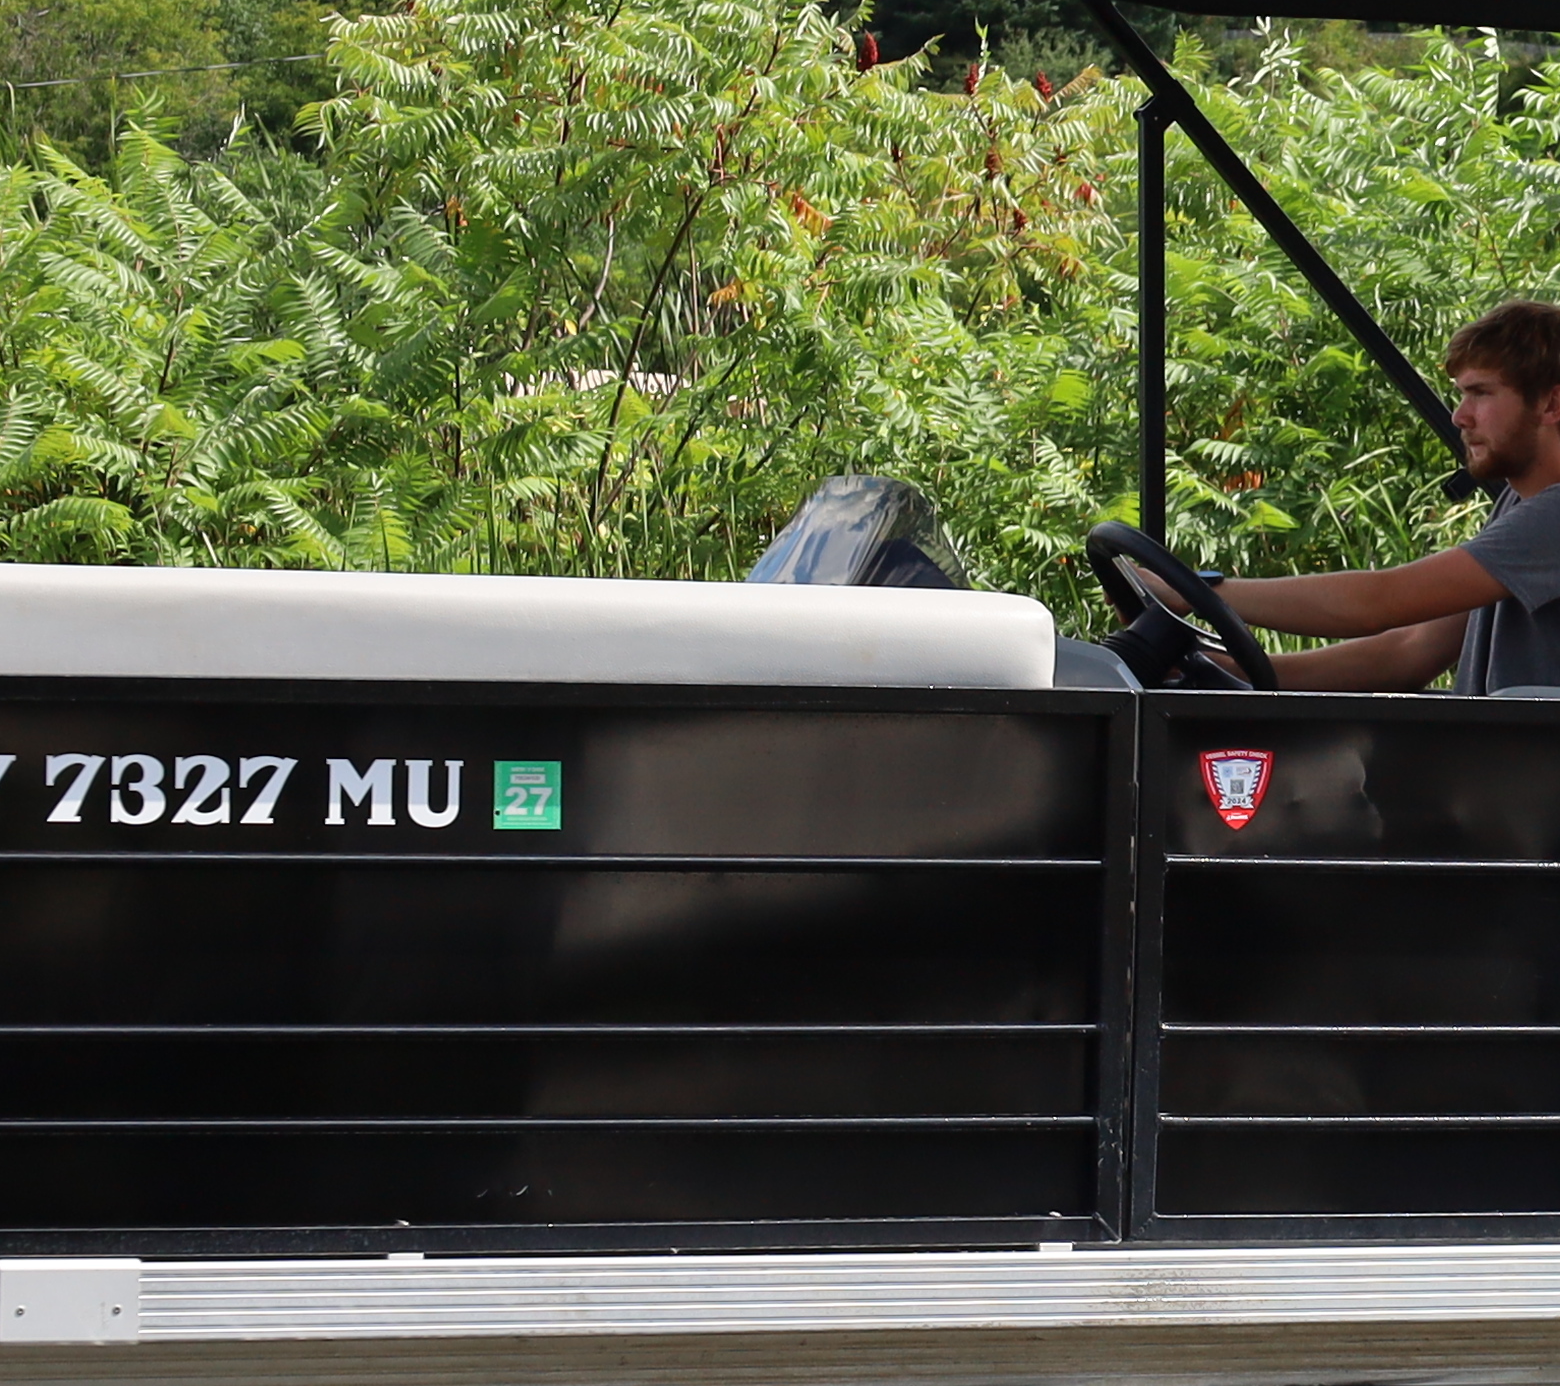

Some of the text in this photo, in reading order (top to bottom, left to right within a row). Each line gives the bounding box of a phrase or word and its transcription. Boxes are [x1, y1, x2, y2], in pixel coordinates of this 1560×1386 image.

[44, 754, 298, 825] 7327
[325, 759, 465, 827] MU
[504, 786, 553, 816] 27
